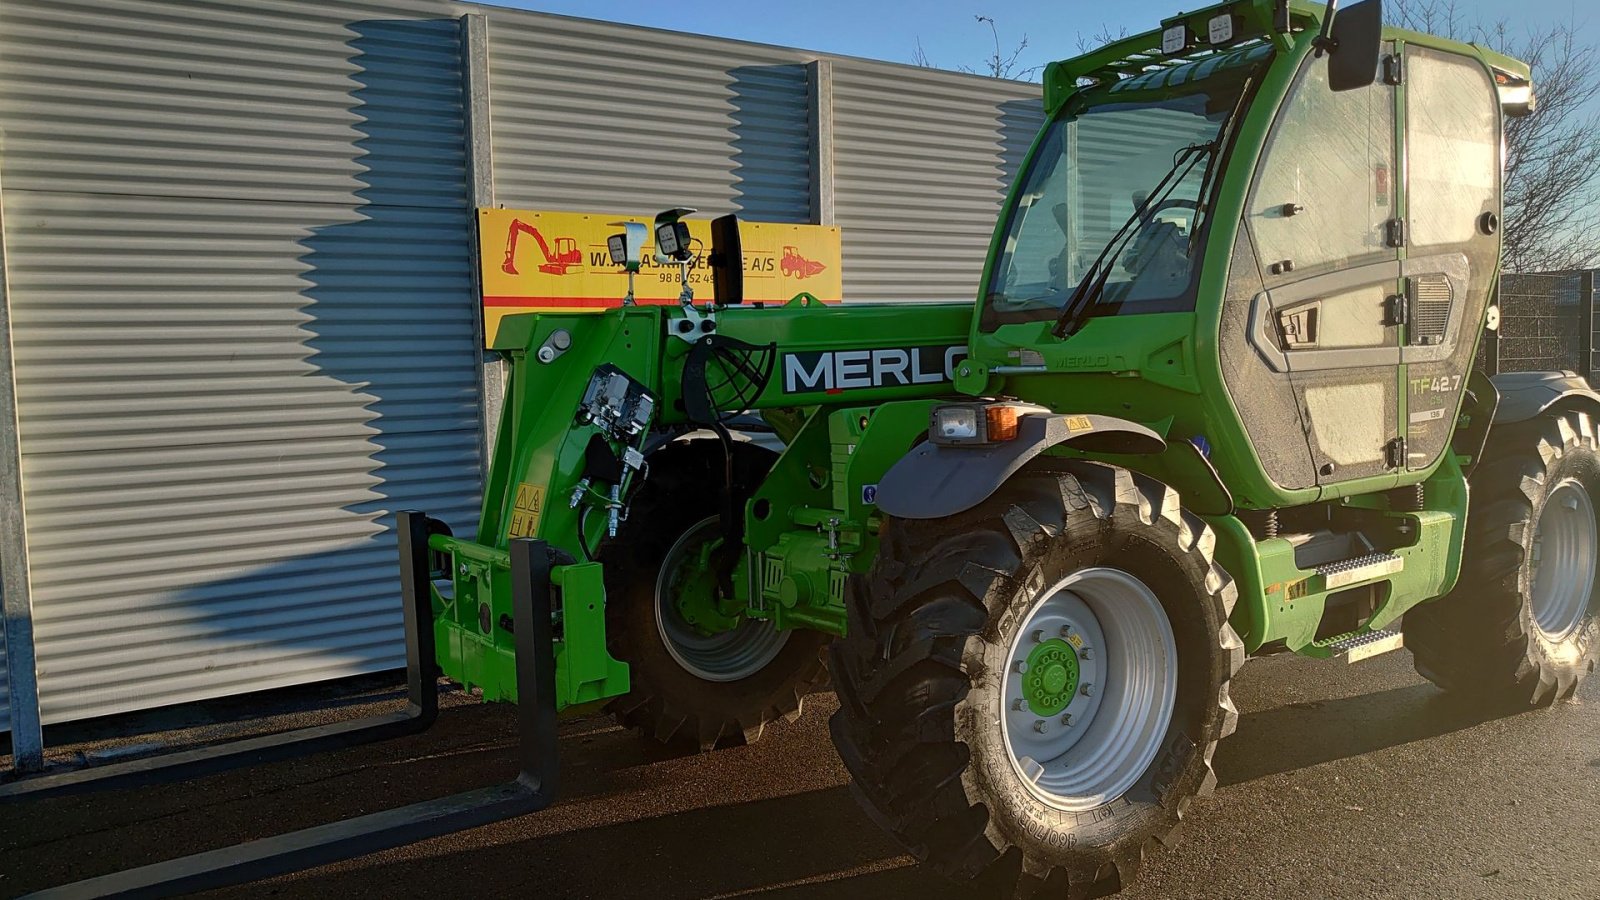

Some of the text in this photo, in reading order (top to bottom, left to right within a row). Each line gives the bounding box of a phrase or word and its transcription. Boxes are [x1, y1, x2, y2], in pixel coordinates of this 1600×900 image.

[751, 257, 775, 271] A/S
[659, 273, 672, 283] 98
[689, 273, 701, 283] 52
[1056, 354, 1109, 368] MERLO
